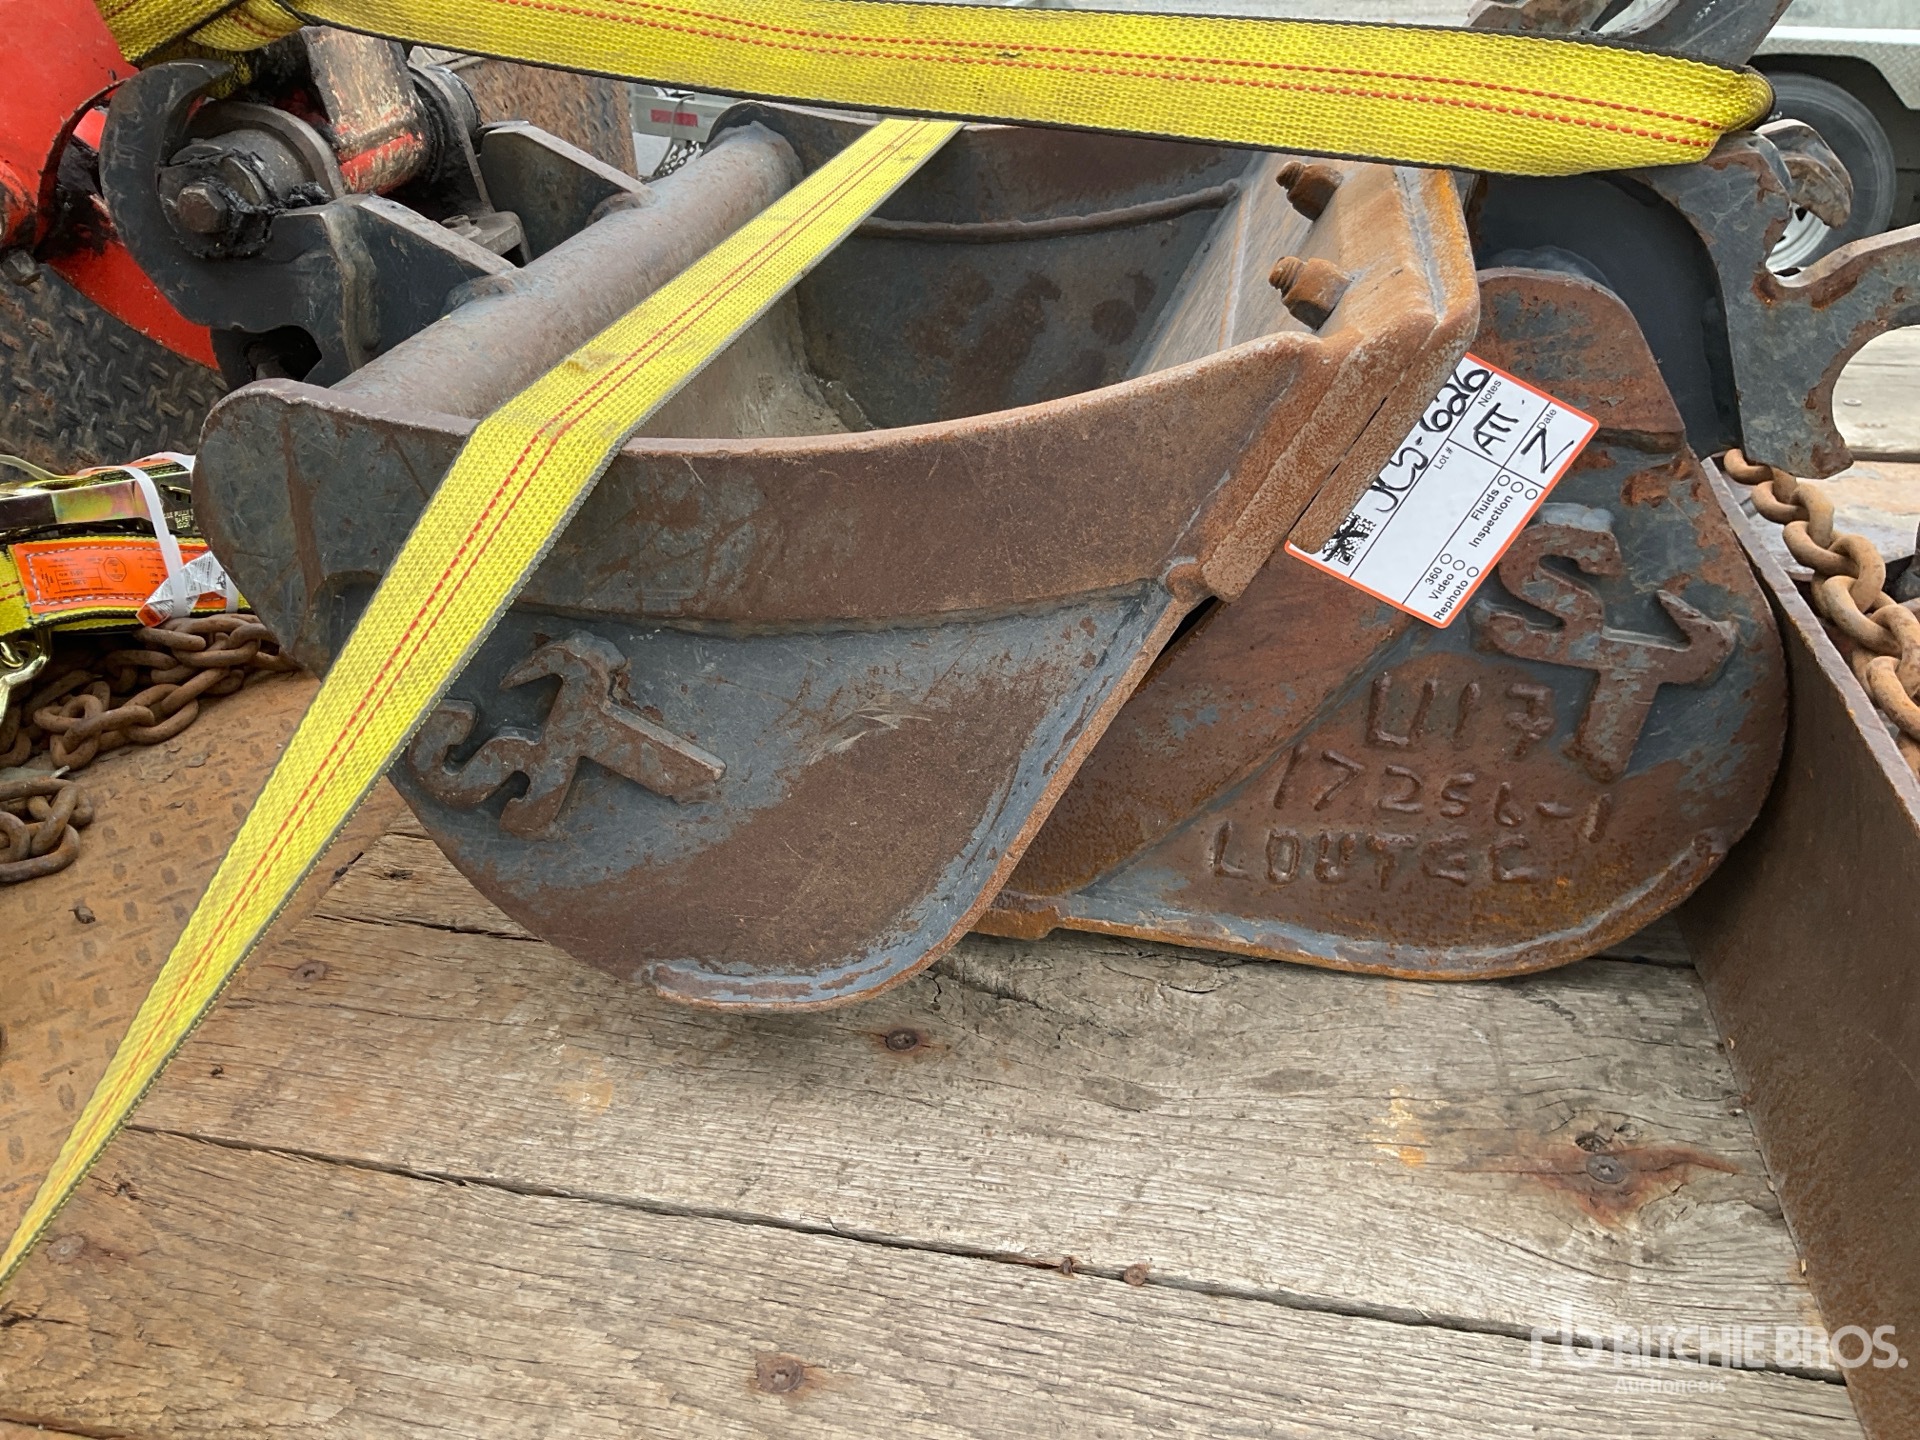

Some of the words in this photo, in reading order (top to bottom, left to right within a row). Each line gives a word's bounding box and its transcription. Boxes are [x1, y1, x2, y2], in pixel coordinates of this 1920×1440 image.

[1477, 378, 1503, 408] Notes
[1535, 407, 1558, 431] Date
[1432, 453, 1450, 471] Lot
[1470, 486, 1500, 521] Fluids
[1468, 493, 1514, 548] Inspection
[1424, 565, 1444, 586] 360
[1428, 572, 1456, 601] Video
[1433, 578, 1470, 621] Rephoto
